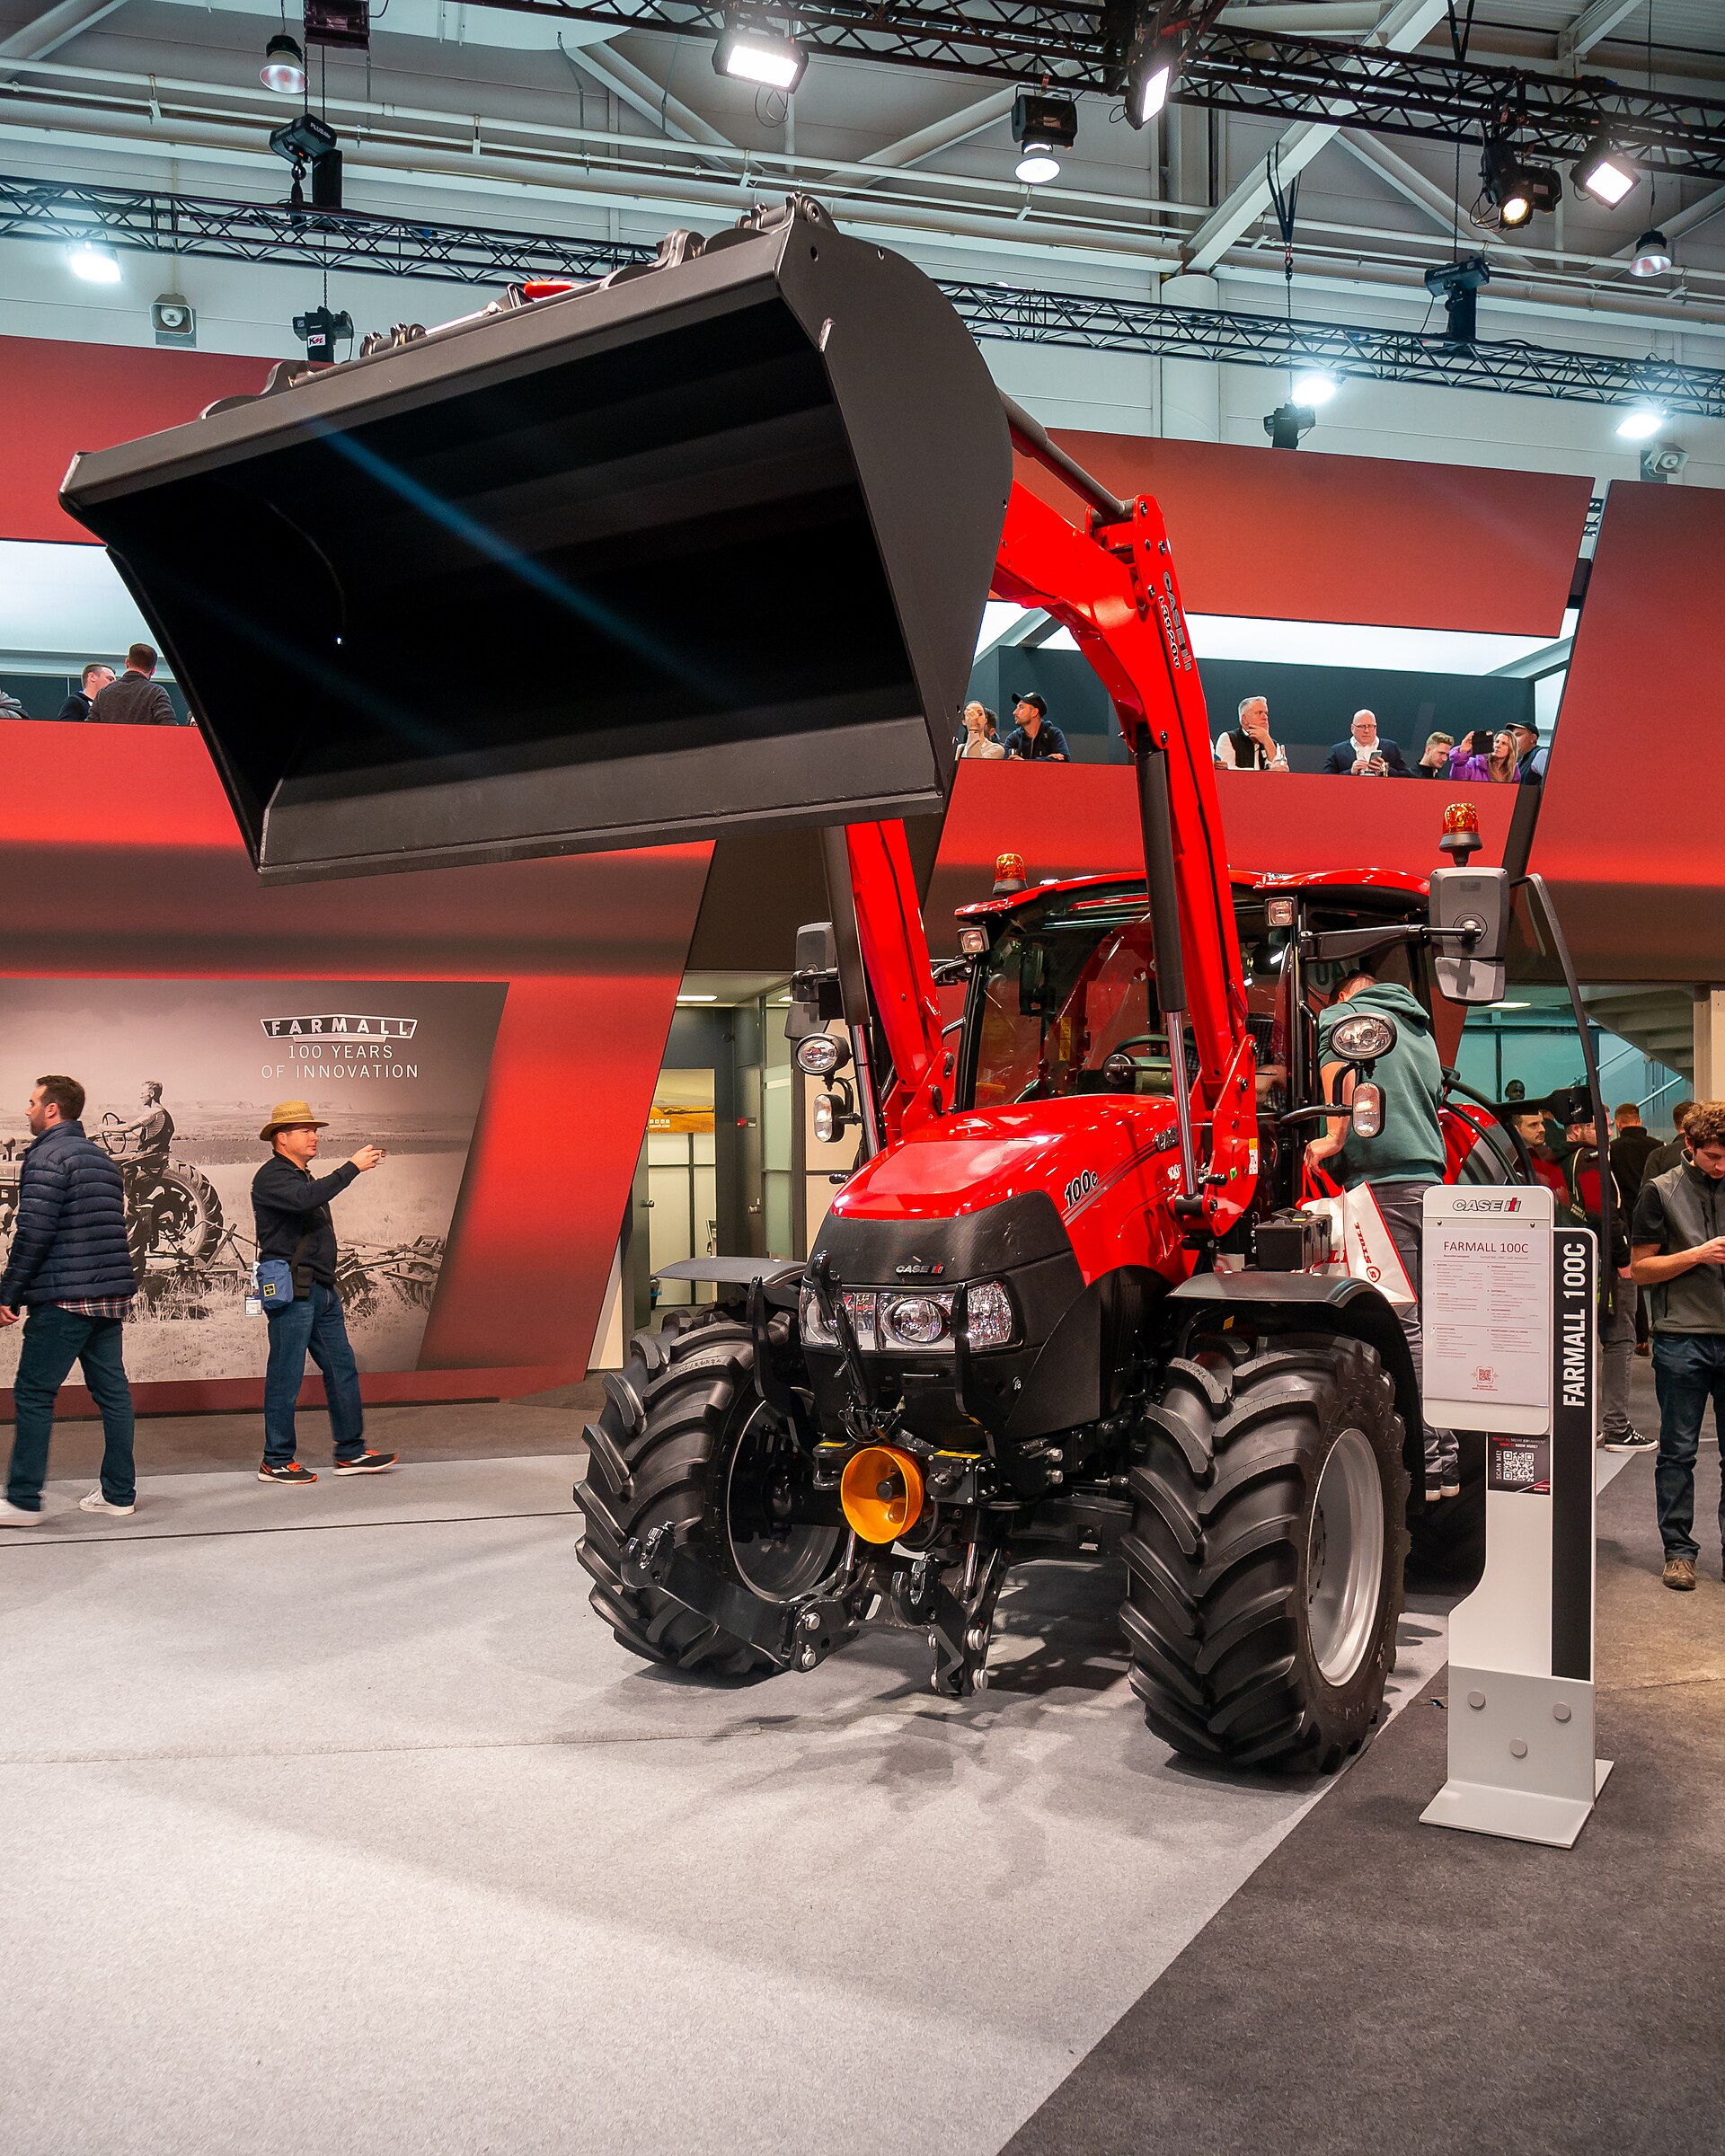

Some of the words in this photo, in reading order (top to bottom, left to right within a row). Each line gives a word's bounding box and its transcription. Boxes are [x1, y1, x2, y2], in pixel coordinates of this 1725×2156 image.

[1163, 570, 1186, 645] CASE
[271, 1017, 408, 1036] FARMALL
[288, 1045, 322, 1058] 100
[331, 1045, 394, 1058] YEARS
[261, 1065, 286, 1078] OF
[296, 1065, 418, 1078] INNOVATION
[1452, 1199, 1504, 1212] CASE
[1443, 1241, 1497, 1253] FARMALL
[1499, 1242, 1529, 1254] 100C
[896, 1265, 930, 1274] CASE
[1562, 1242, 1586, 1299] 100C
[1562, 1308, 1586, 1407] FARMALL
